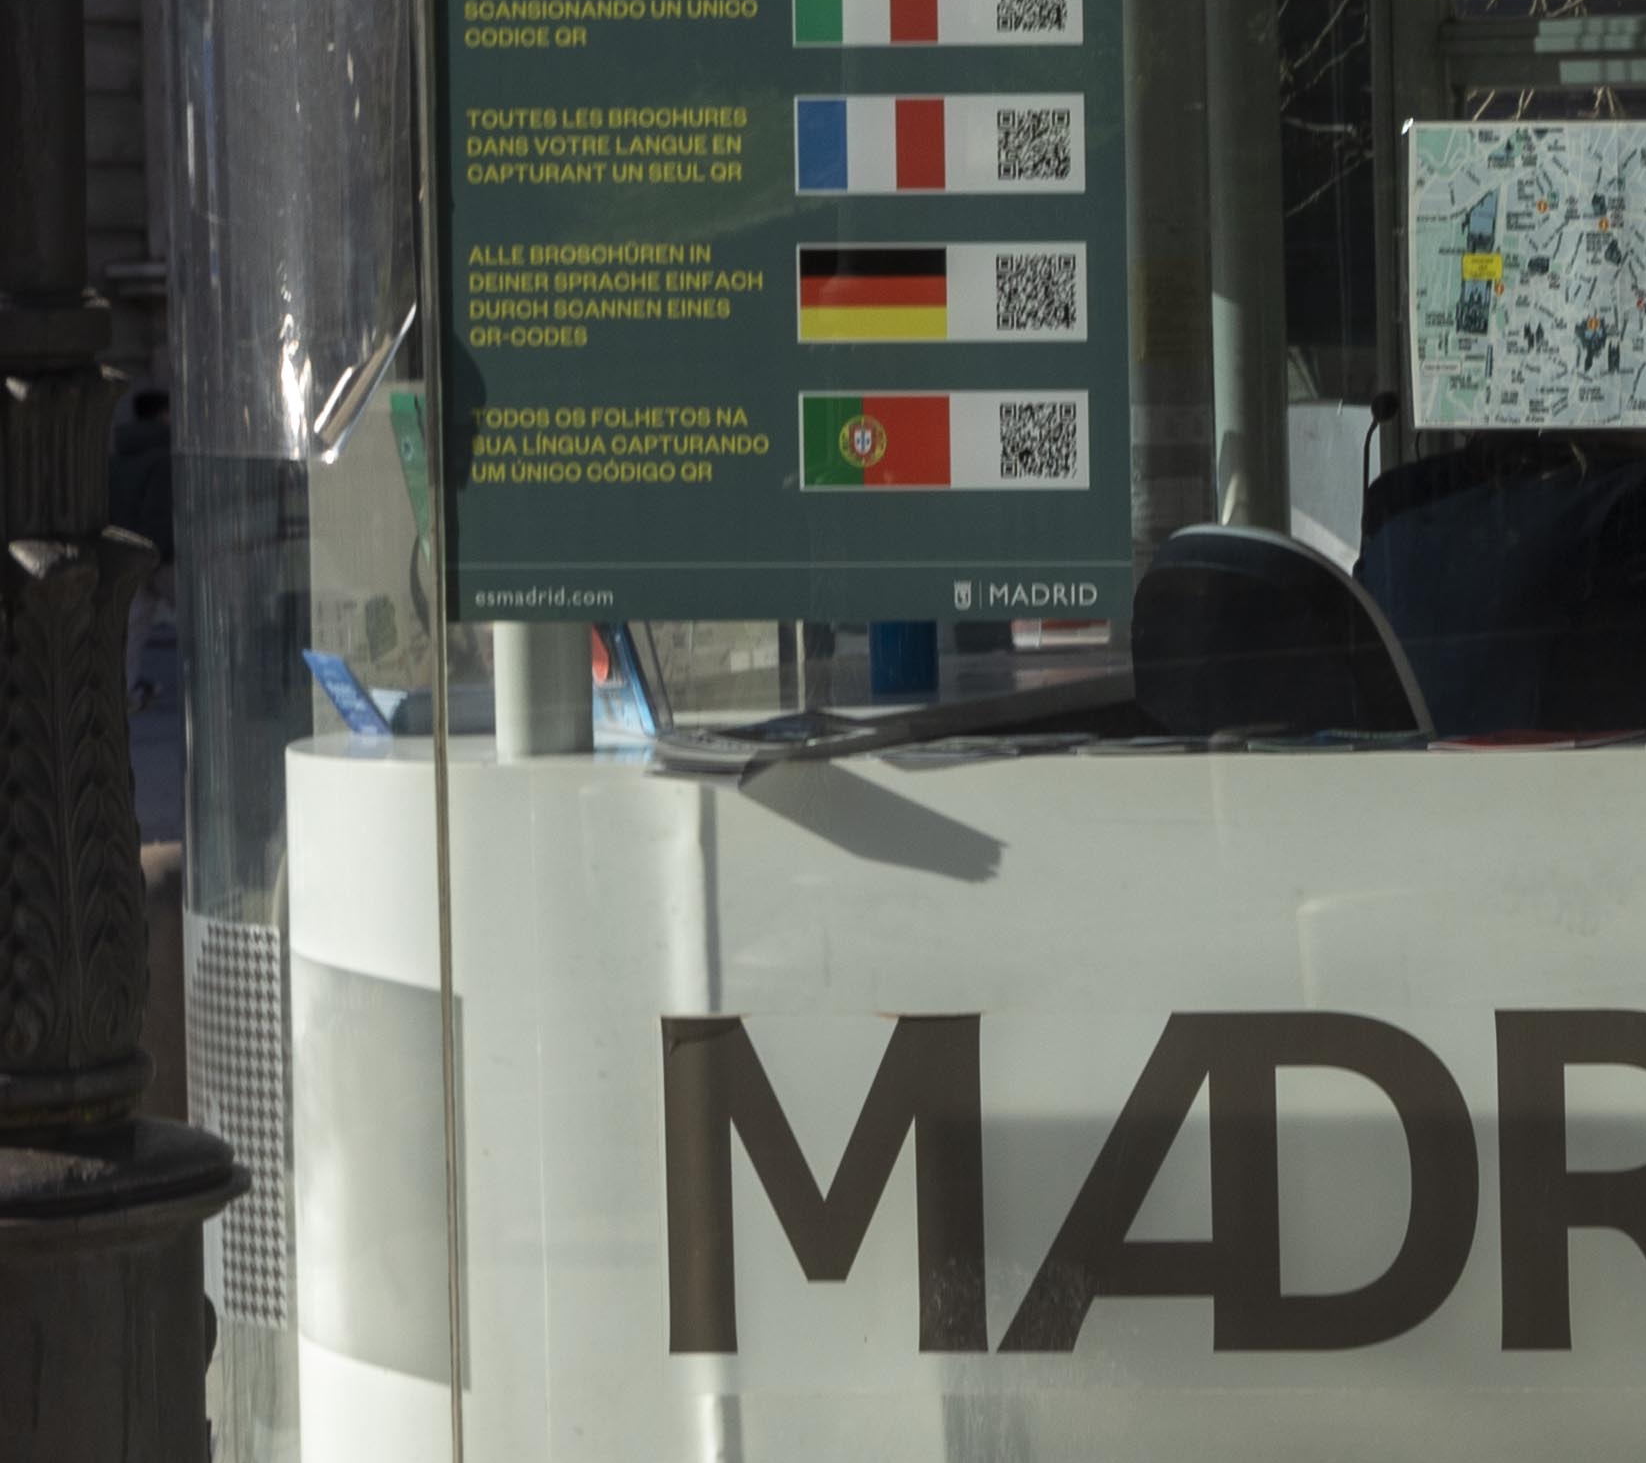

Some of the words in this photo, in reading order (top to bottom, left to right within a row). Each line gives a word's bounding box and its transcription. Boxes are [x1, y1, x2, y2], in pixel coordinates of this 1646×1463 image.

[464, 0, 646, 21] SCANSIONANDO
[650, 0, 682, 19] UN
[464, 26, 548, 47] CODICE
[554, 26, 587, 46] QR
[469, 109, 556, 129] TOUTES
[562, 109, 604, 129] LES
[608, 107, 747, 127] BROCHURES
[466, 137, 528, 156] DANS
[534, 136, 608, 155] VOTRE
[615, 134, 706, 156] LANGUE
[712, 134, 742, 154] EN
[467, 163, 605, 183] CAPTURANT
[611, 163, 644, 183] UN
[648, 162, 705, 183] SEUL
[709, 160, 743, 182] QR
[475, 586, 613, 606] esmadrid.com
[990, 583, 1097, 606] MADRID
